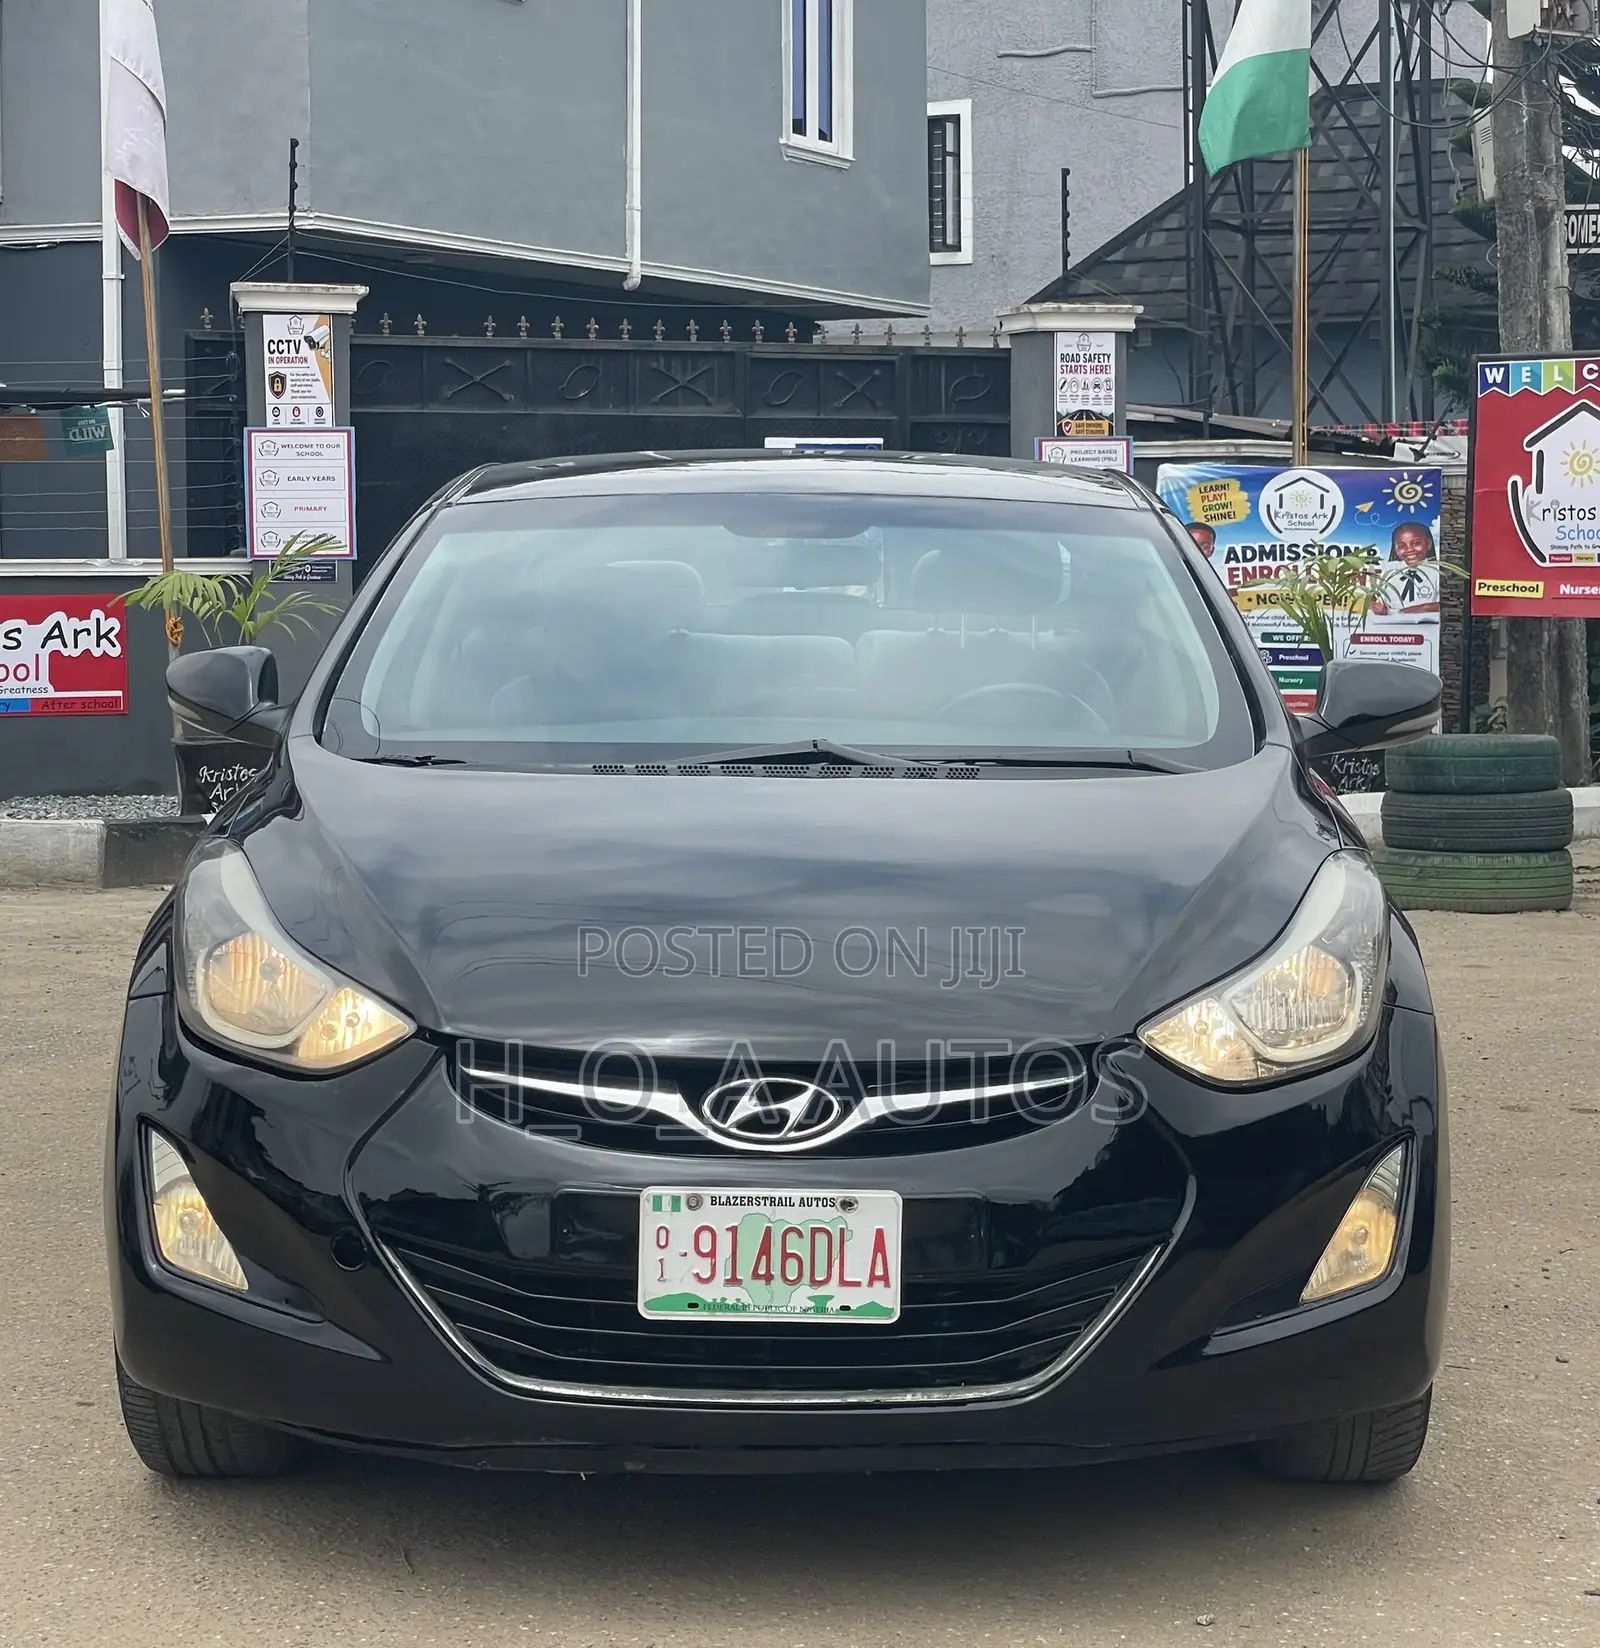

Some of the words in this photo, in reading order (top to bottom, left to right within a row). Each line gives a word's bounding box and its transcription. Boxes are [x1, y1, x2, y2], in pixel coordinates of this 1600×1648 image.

[268, 339, 301, 355] CCTV
[268, 356, 275, 364] IN
[276, 356, 308, 364] OPERATION
[1060, 353, 1080, 363] ROAD
[1082, 353, 1111, 363] SAFETY
[1060, 364, 1088, 375] STARTS
[1090, 364, 1112, 375] HERE!
[1199, 483, 1230, 494] LEARN!
[1201, 492, 1227, 504] PLAY!
[1202, 502, 1232, 513] GROW!
[1204, 511, 1237, 523] SHINE!
[1478, 582, 1539, 593] Preschool
[40, 618, 116, 649] Ark
[1279, 677, 1304, 685] Nursery
[41, 700, 77, 711] After
[81, 699, 118, 709] school
[710, 1196, 796, 1208] BLAZERSTRAIL
[798, 1196, 837, 1208] AUTOS
